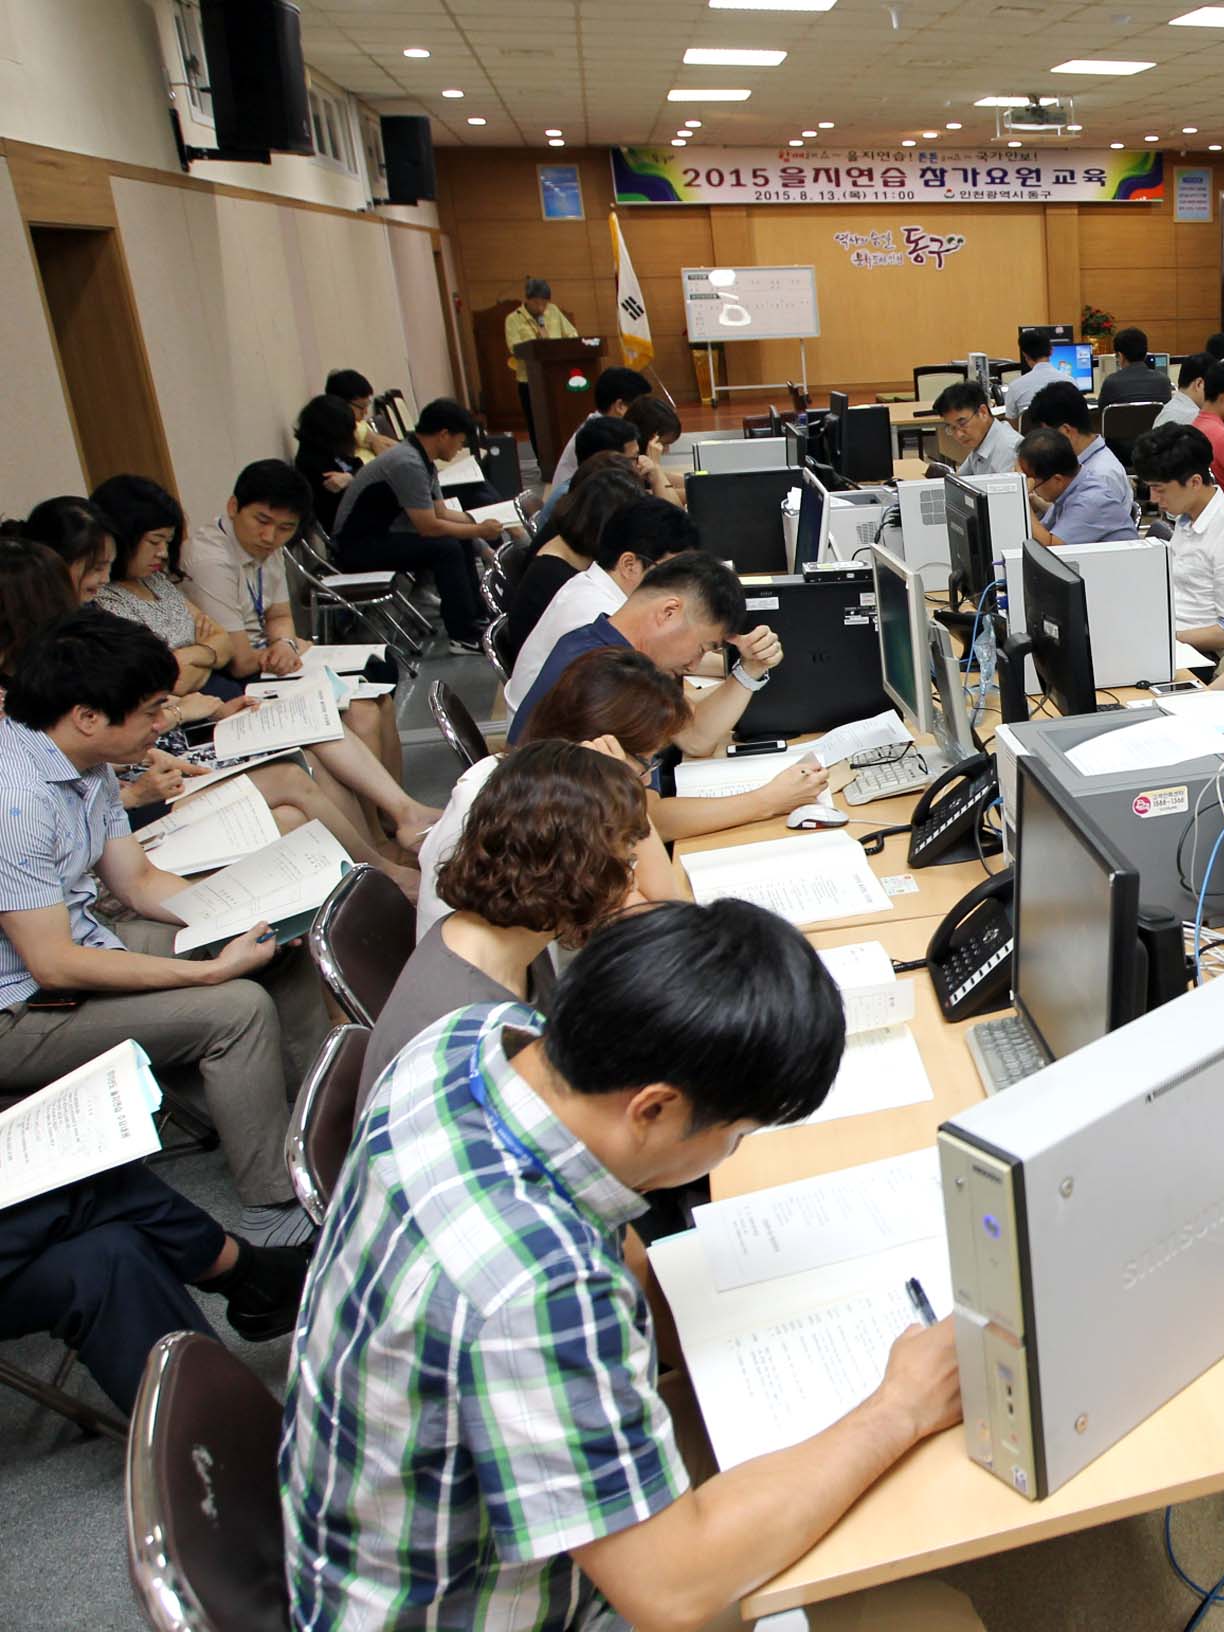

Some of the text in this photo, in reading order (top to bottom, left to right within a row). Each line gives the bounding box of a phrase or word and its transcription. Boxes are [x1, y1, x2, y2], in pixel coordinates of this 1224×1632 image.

[682, 166, 1108, 188] 2015 을지연습 참가요원 교육
[874, 190, 915, 200] 11:00
[901, 226, 961, 269] 동구
